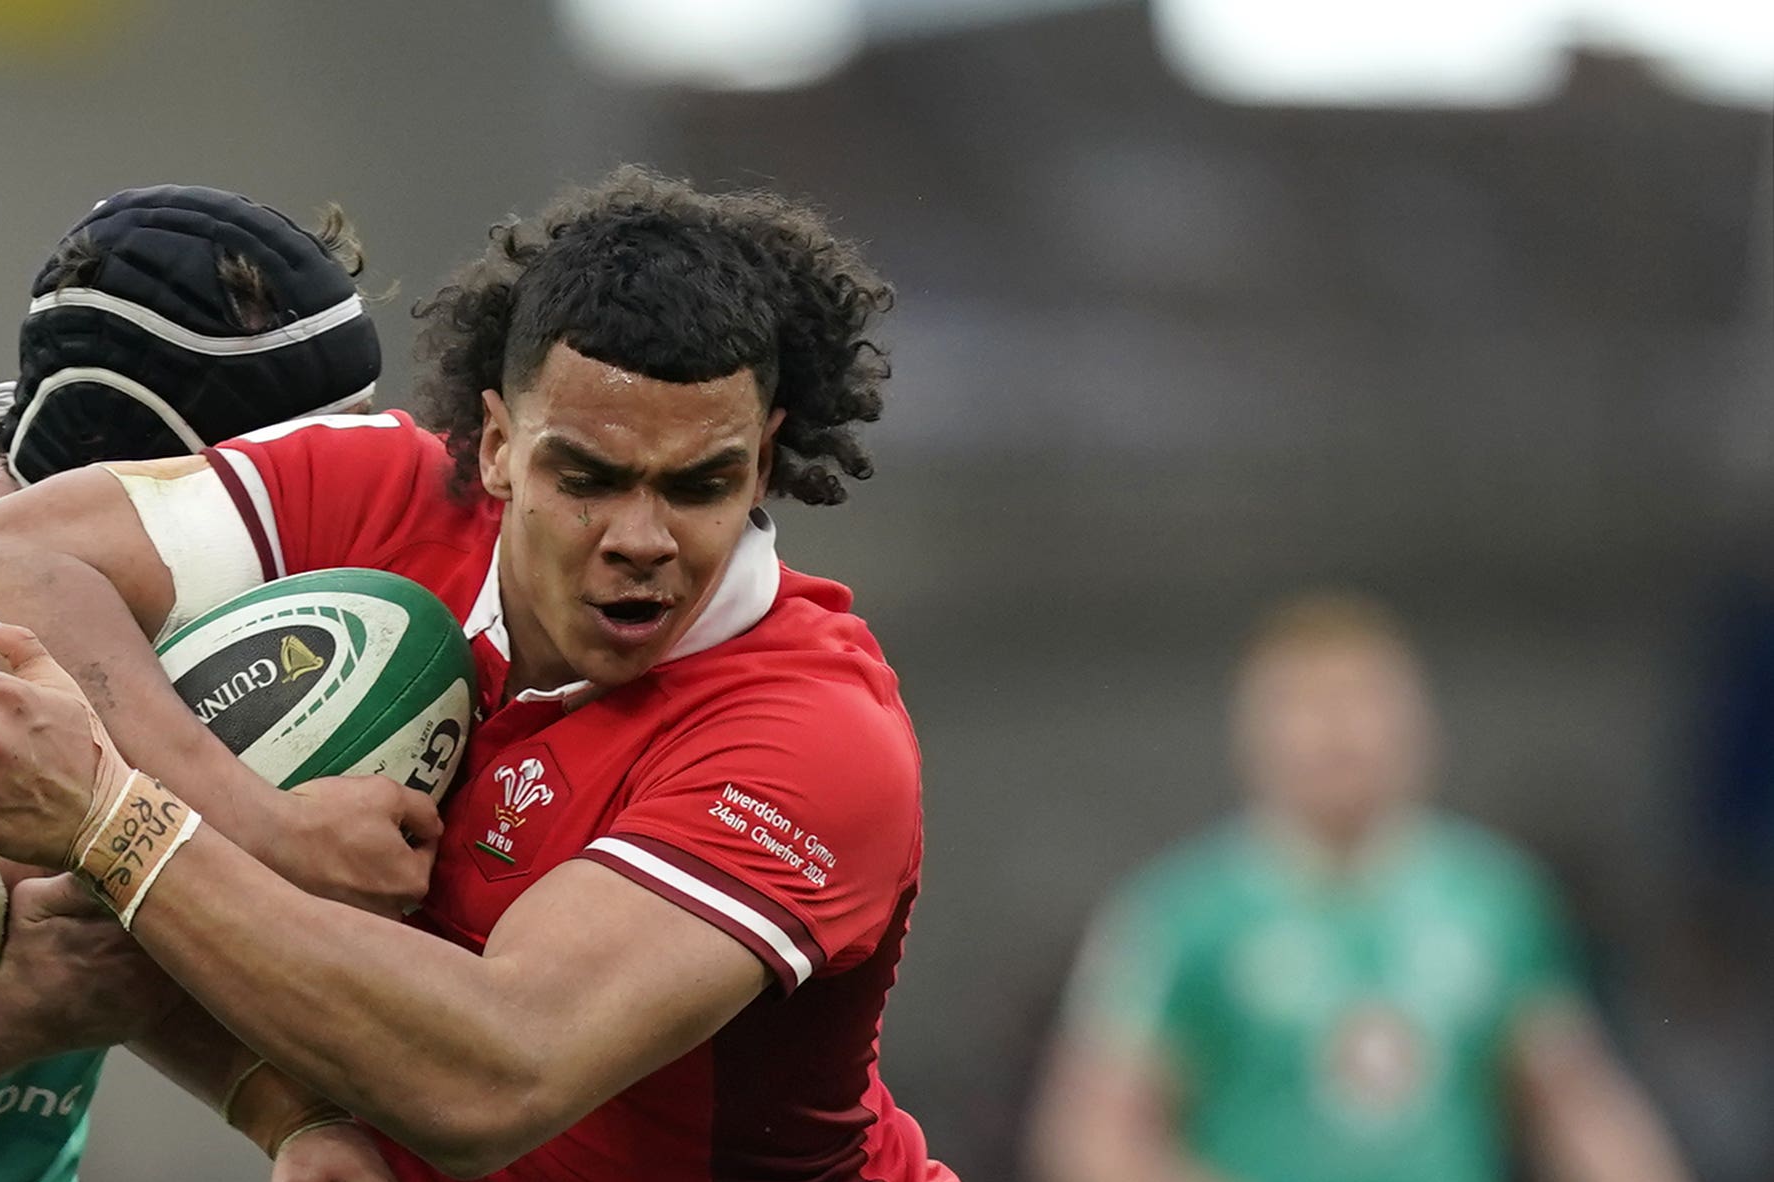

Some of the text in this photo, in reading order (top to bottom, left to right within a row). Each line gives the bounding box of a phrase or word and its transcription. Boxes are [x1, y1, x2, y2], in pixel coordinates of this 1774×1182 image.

[485, 829, 514, 853] WRU
[708, 801, 828, 887] 24ain Chwefror 2024
[722, 783, 837, 868] Iwerddon v Cymru
